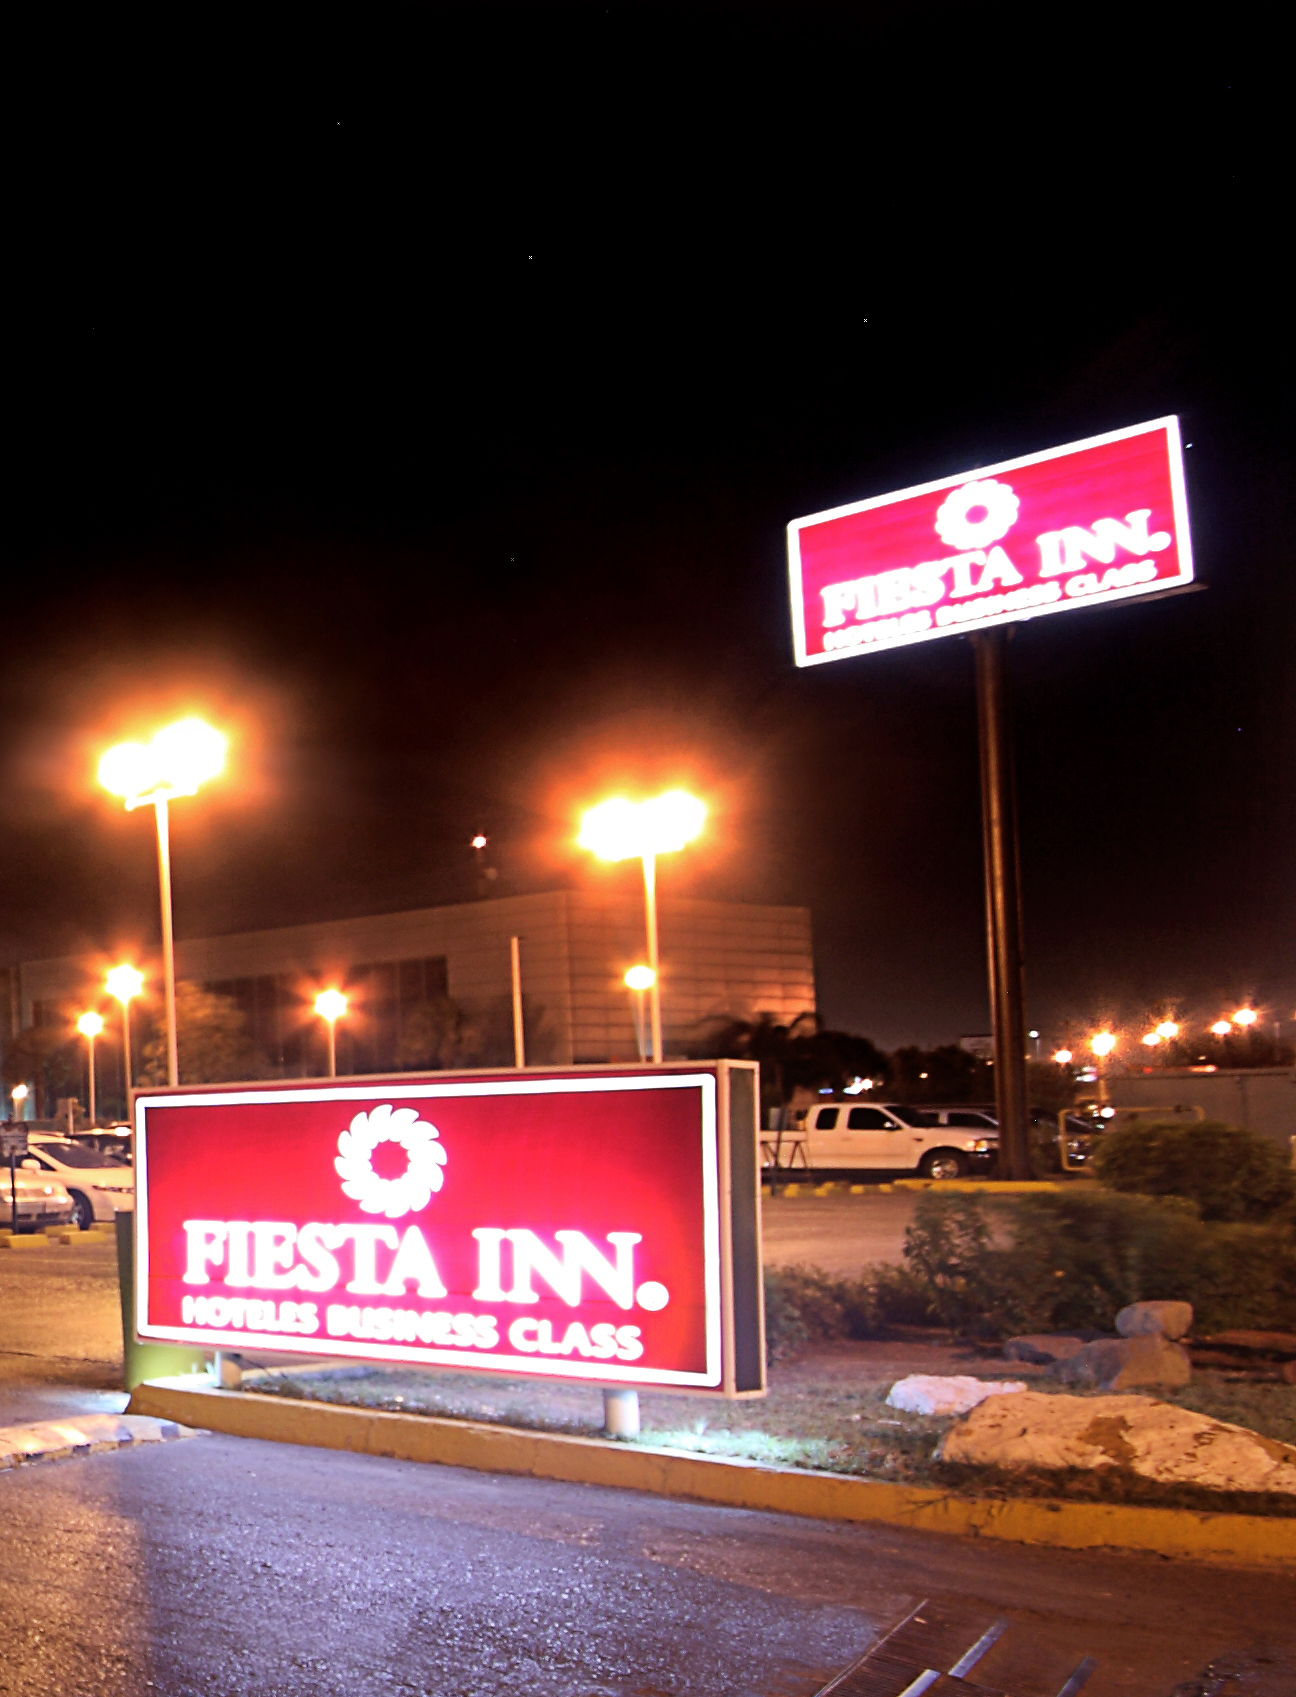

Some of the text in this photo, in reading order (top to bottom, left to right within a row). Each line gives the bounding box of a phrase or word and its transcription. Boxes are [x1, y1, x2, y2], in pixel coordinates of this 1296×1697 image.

[820, 545, 1024, 628] FIESTA
[182, 1219, 448, 1299] FIESTA
[182, 1295, 644, 1361] HOTELES BUSINESS CLASS
